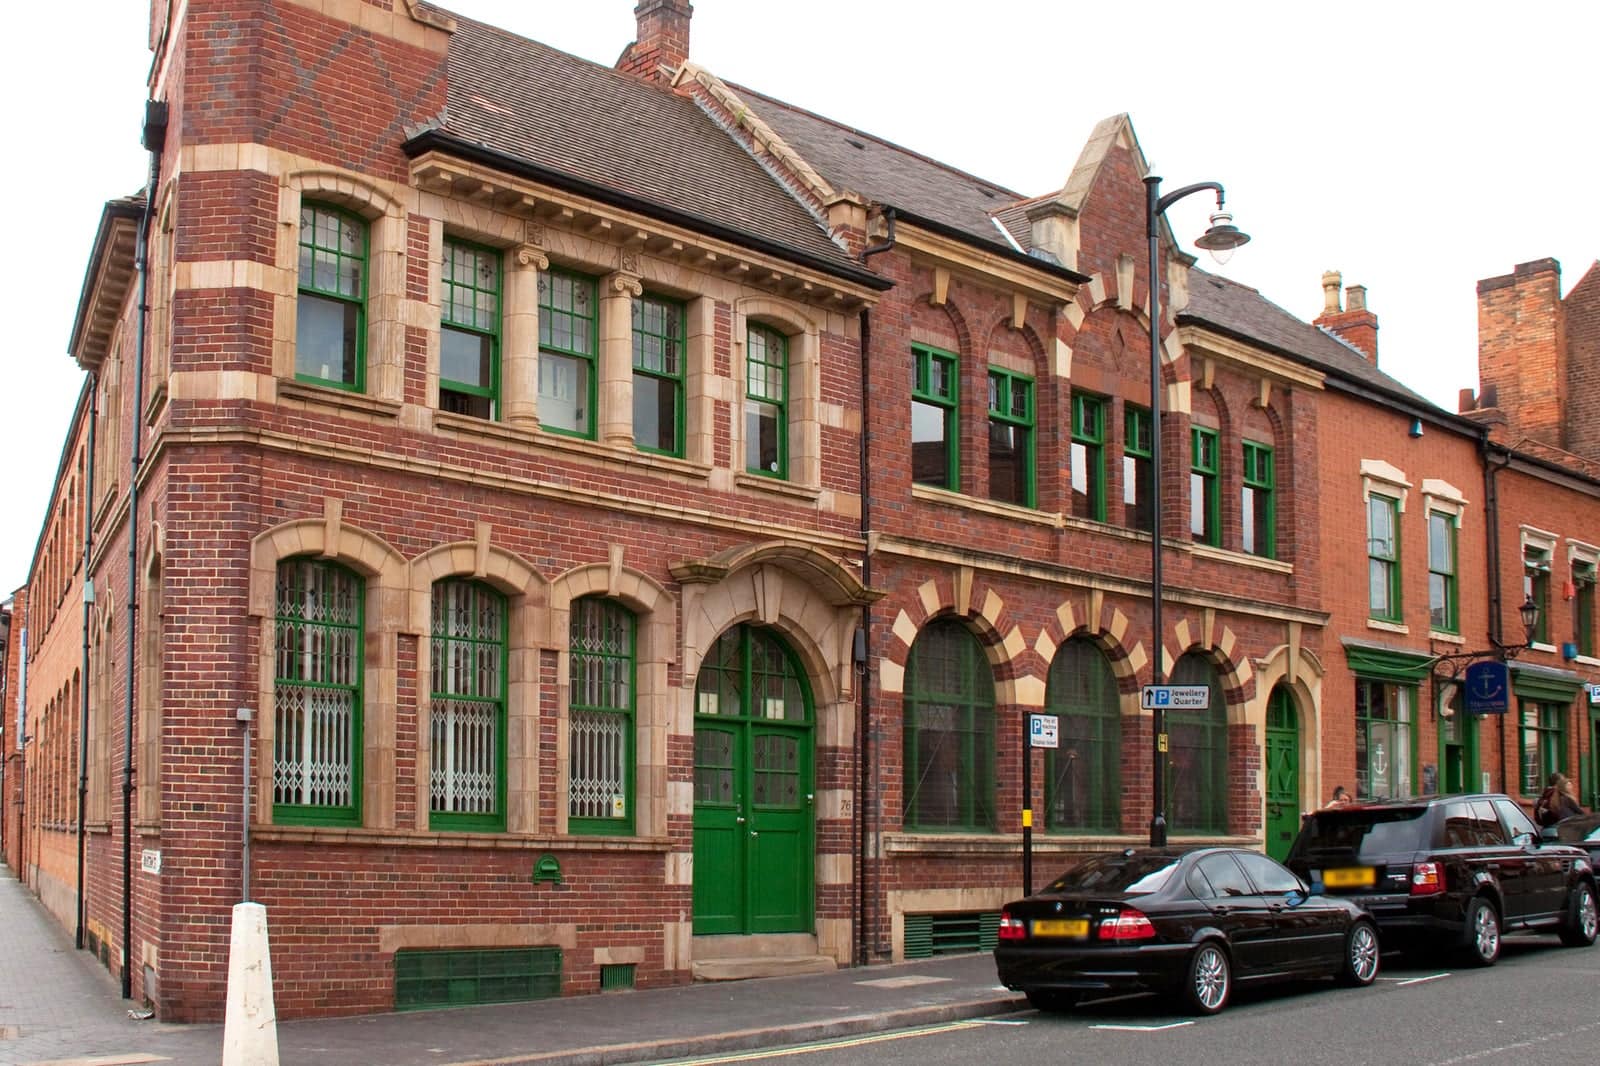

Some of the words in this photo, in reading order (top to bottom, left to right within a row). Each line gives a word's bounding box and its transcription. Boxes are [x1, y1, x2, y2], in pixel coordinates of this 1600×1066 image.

[1158, 691, 1167, 704] P
[1171, 689, 1206, 697] Jewellery
[1174, 697, 1202, 705] Quarter
[1034, 720, 1040, 733] P
[840, 799, 851, 810] 76
